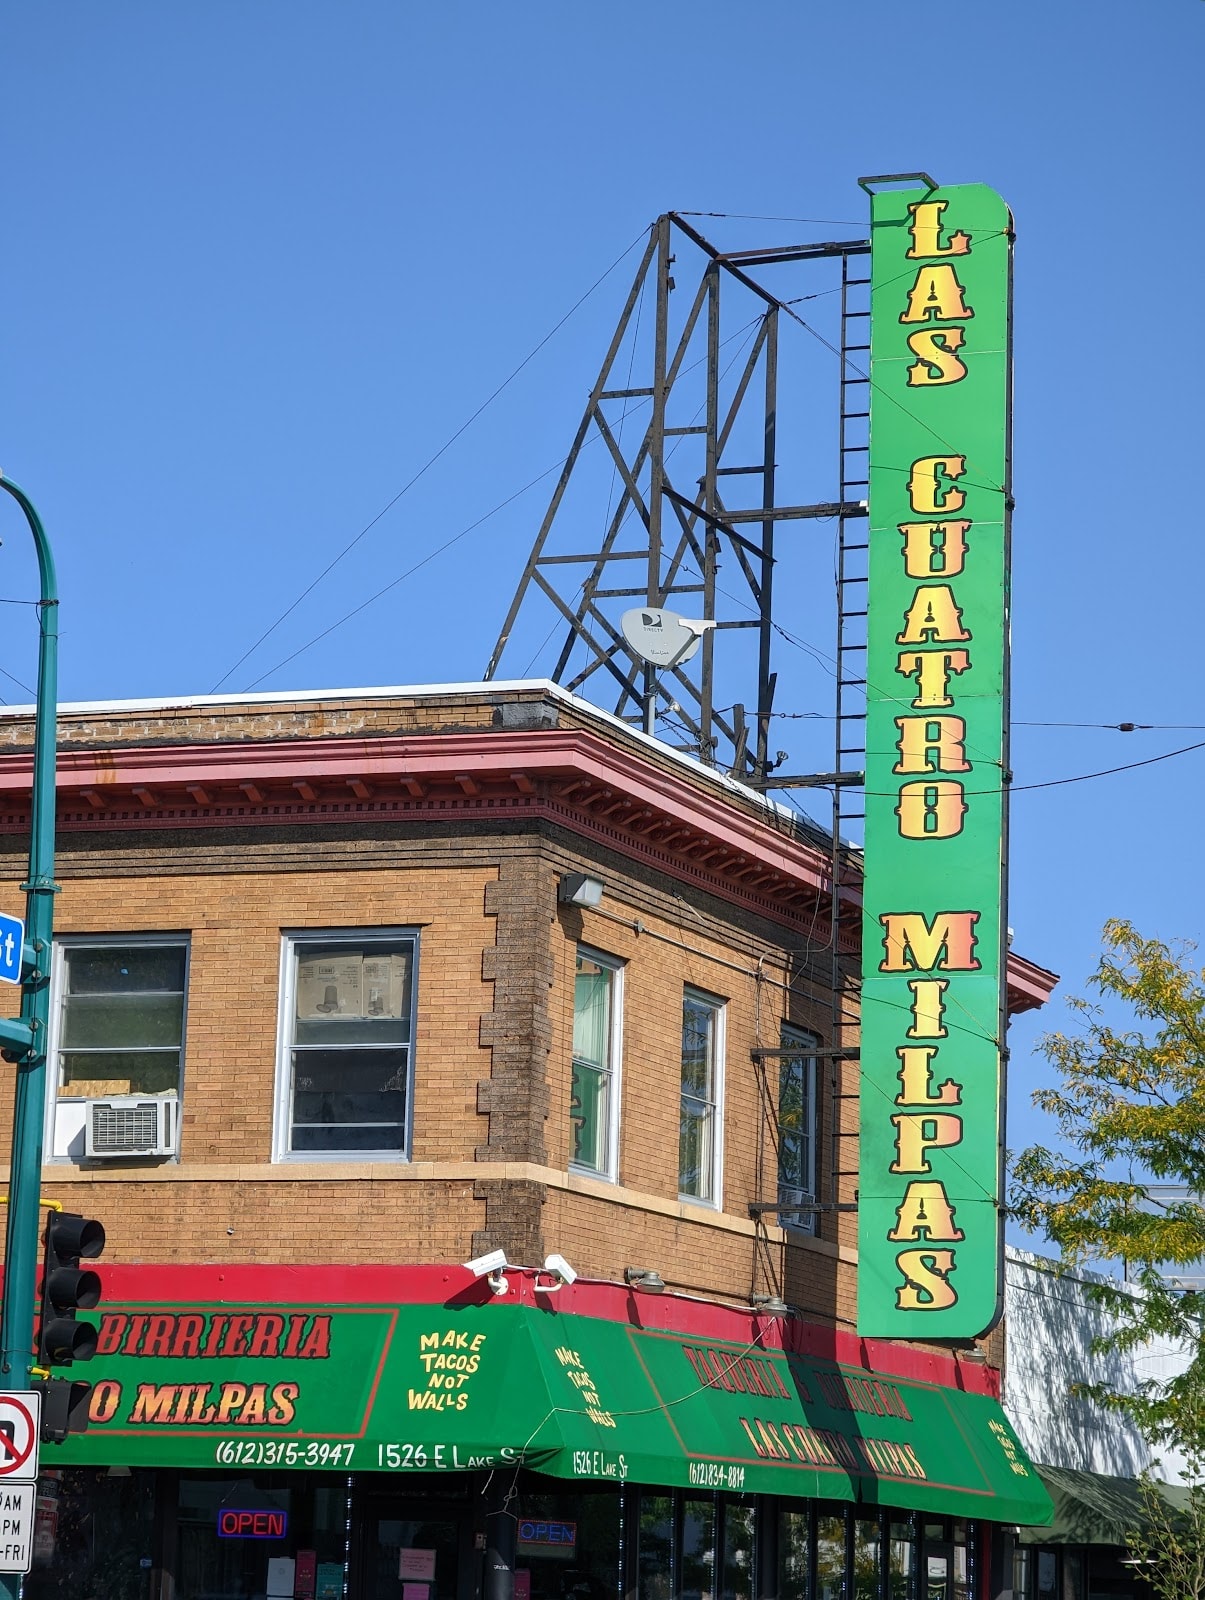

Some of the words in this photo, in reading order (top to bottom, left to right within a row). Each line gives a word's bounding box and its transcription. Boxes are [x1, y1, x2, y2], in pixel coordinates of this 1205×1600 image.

[899, 200, 975, 388] LAS
[893, 454, 972, 841] CUATRO
[878, 910, 982, 1311] MILPAS
[96, 1313, 331, 1359] BIRRIERIA
[420, 1330, 486, 1351] MAKE
[420, 1353, 480, 1373] TACOS
[555, 1346, 584, 1369] MAKE
[428, 1373, 469, 1389] NOT
[127, 1382, 299, 1425] MILPAS
[408, 1389, 468, 1411] WALLS
[216, 1441, 355, 1466] (612)315-3947
[378, 1444, 427, 1468] 1526
[434, 1444, 447, 1468] E
[739, 1416, 791, 1461] LAS
[781, 1423, 859, 1470] CUATRO
[854, 1436, 927, 1481] MILPAS
[573, 1451, 591, 1474] 1526
[593, 1451, 599, 1475] E
[689, 1462, 745, 1488] (612)834-8814
[222, 1512, 283, 1535] OPEN
[520, 1523, 573, 1542] OPEN
